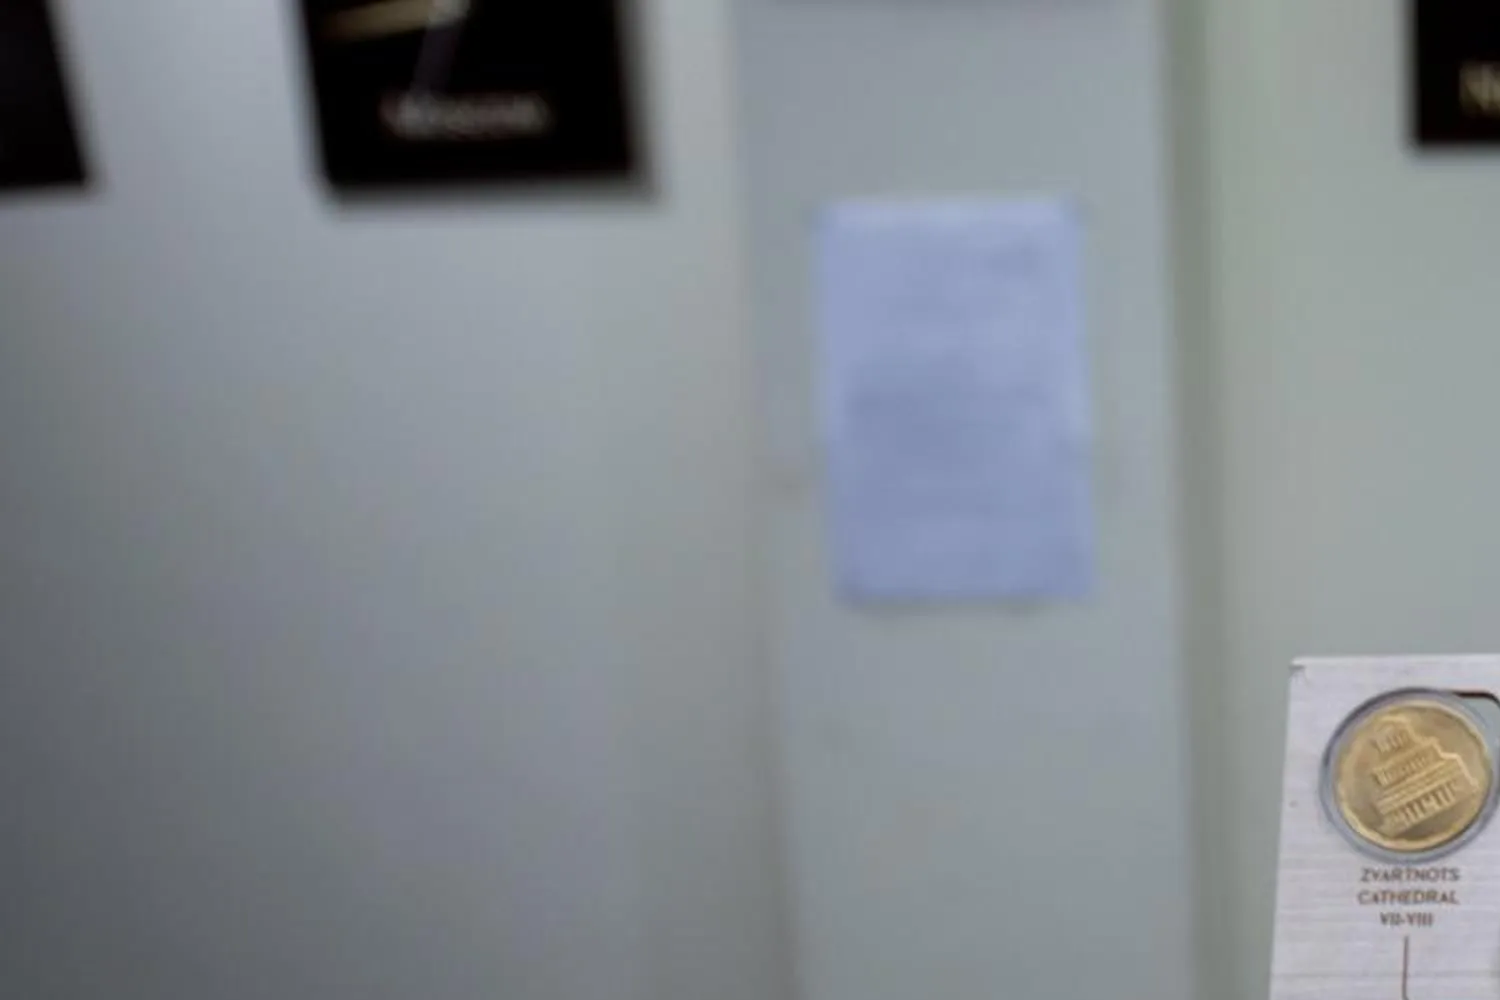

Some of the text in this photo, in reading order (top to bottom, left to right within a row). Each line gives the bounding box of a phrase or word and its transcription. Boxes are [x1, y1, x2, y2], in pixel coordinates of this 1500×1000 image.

[1360, 867, 1460, 884] ZVARTNOTS
[1358, 890, 1458, 907] CATHEDRAL
[1380, 912, 1434, 928] VII-VIII
